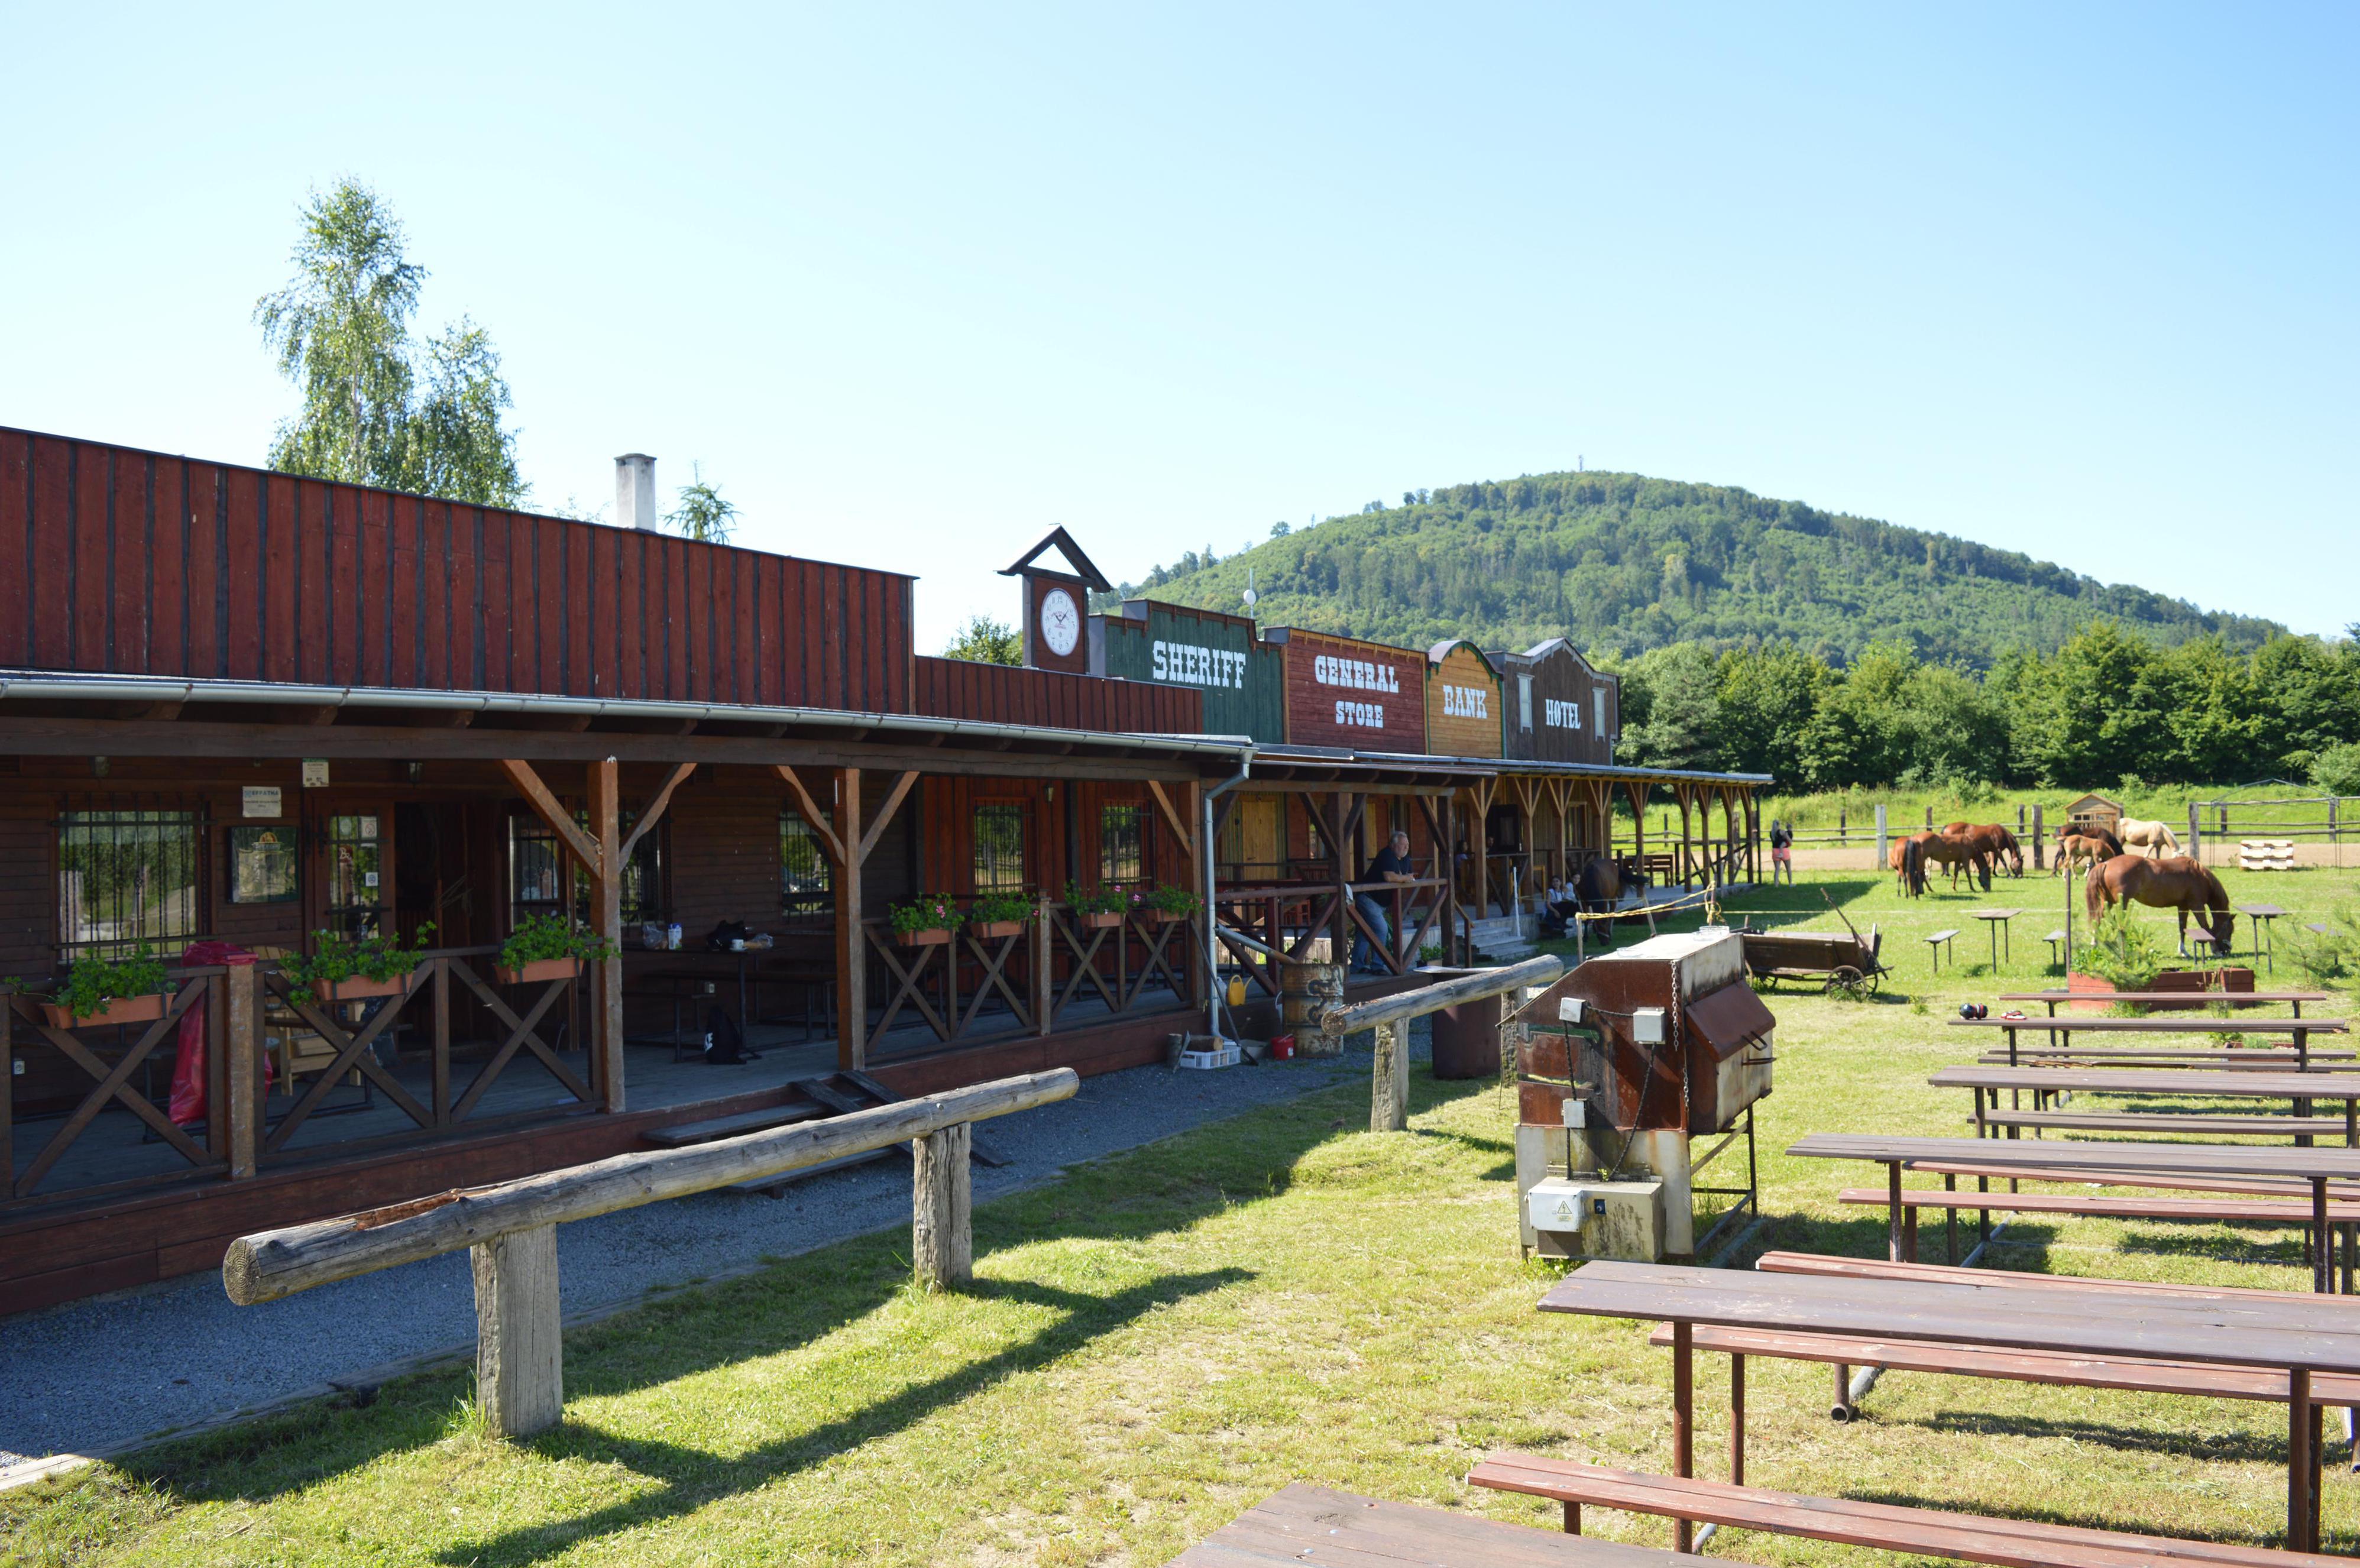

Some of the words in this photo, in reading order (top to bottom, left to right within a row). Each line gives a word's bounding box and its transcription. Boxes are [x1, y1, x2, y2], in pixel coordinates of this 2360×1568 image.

[1153, 640, 1246, 689] SHERIFF
[1315, 655, 1399, 693] GENERAL
[1335, 700, 1384, 728] STORE
[1443, 685, 1487, 719] BANK
[1545, 699, 1581, 730] HOTEL
